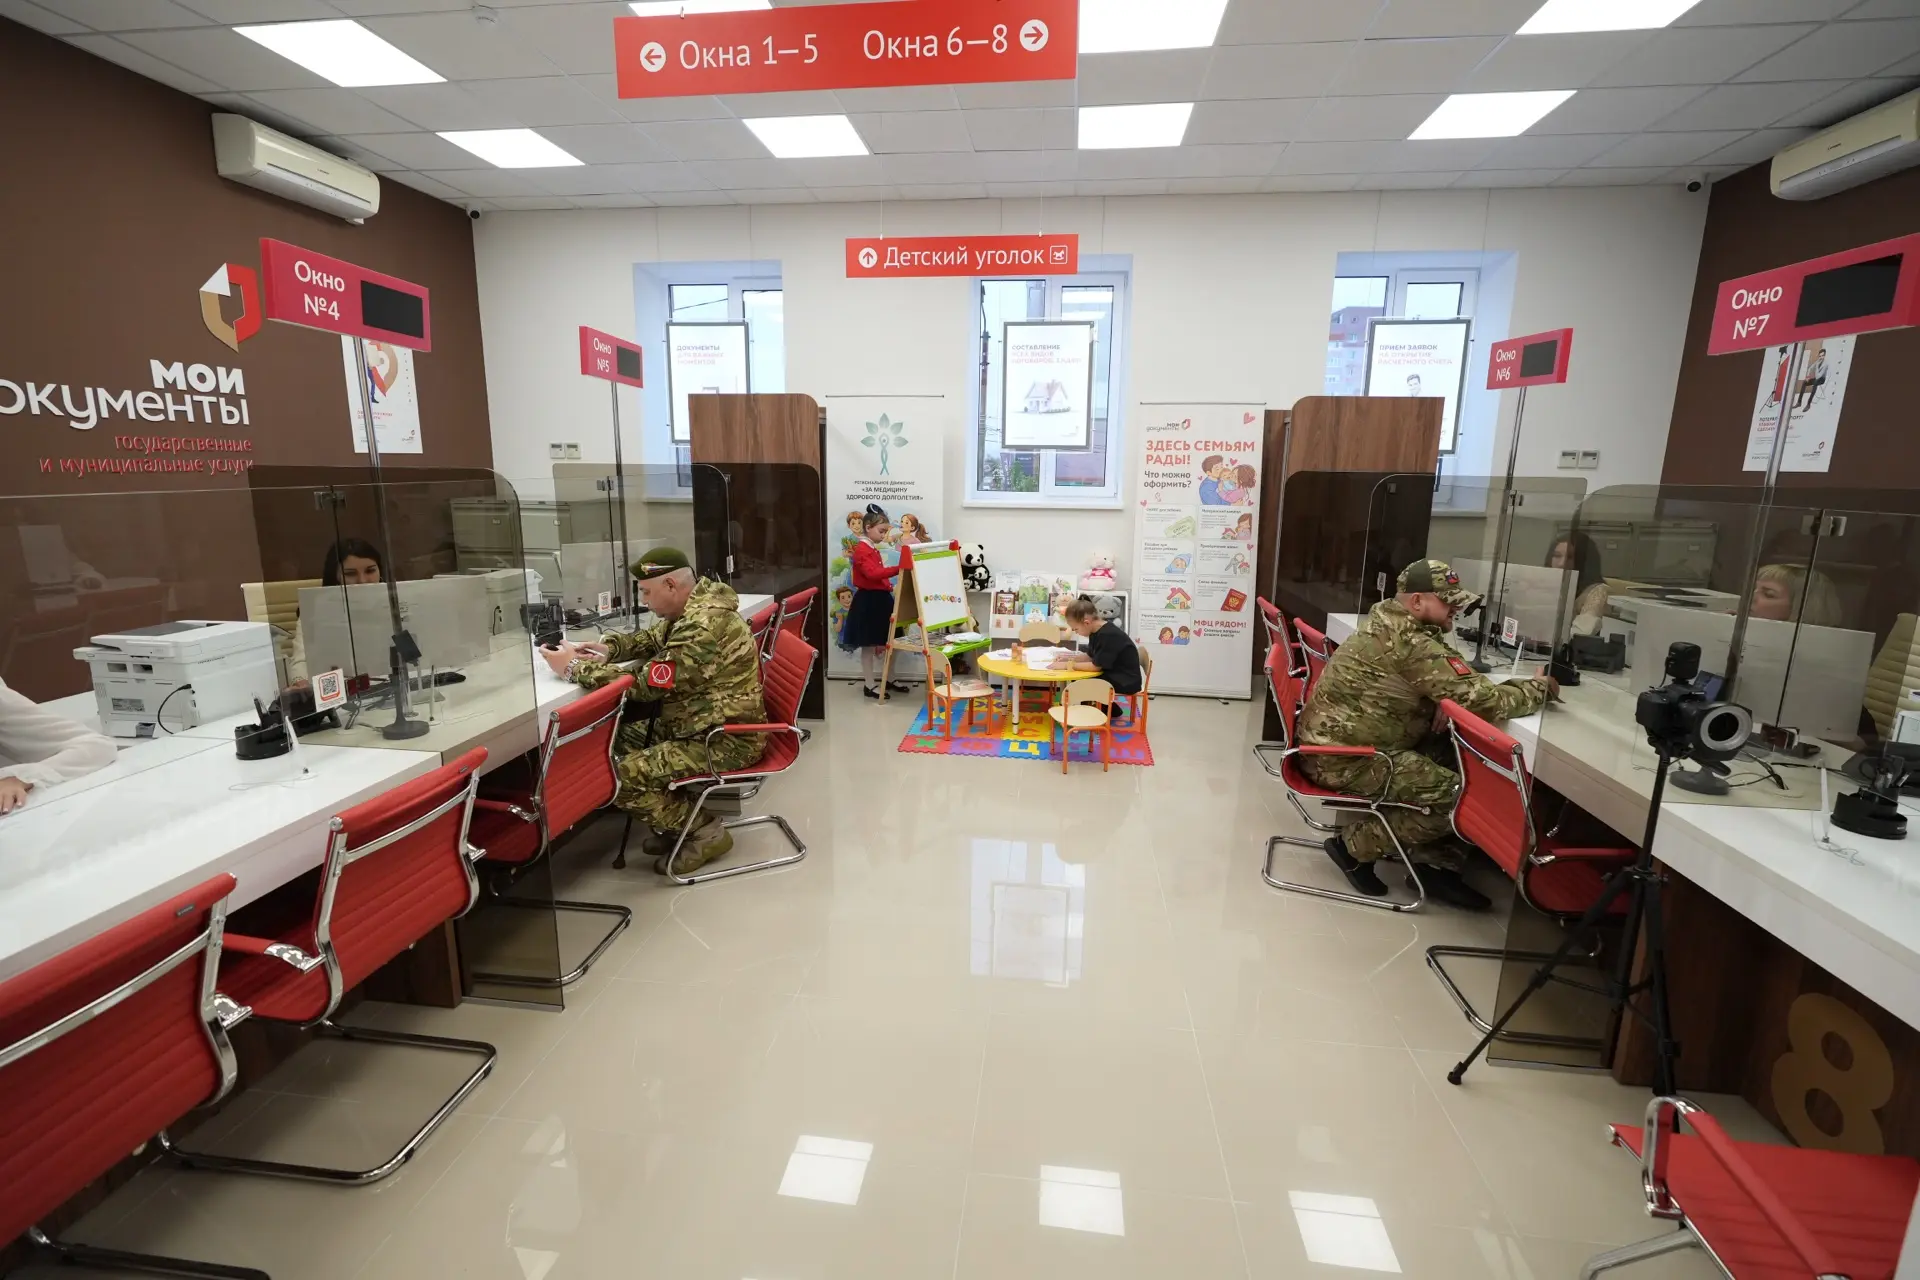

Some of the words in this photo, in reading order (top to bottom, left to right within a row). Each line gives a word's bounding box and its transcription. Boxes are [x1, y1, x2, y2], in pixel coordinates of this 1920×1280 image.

[679, 39, 751, 69] Окна
[863, 29, 938, 60] Окна
[883, 245, 968, 270] Детский
[975, 249, 1044, 270] уголок
[294, 260, 345, 292] Окно
[304, 293, 341, 321] №4
[1731, 285, 1783, 310] Окно
[1732, 314, 1770, 339] №7
[593, 337, 612, 355] Окно
[676, 344, 721, 352] ДОКУМЕНТЫ
[1496, 348, 1516, 362] Окно
[597, 357, 610, 373] №5
[1496, 366, 1511, 382] №6
[0, 378, 250, 431] окументы
[115, 434, 252, 455] государственные
[1146, 440, 1191, 452] ЗДЕСЬ
[1194, 440, 1255, 452] СЕМЬЯМ
[39, 458, 52, 473] и
[59, 457, 204, 478] муниципальные
[207, 458, 254, 476] услуги
[1146, 454, 1191, 467] РАДЫ!
[1144, 470, 1160, 479] Что
[1144, 480, 1192, 489] оформить?
[1194, 619, 1213, 627] МФЦ
[1215, 620, 1247, 628] РЯДОМ!
[1771, 992, 1894, 1155] 8
